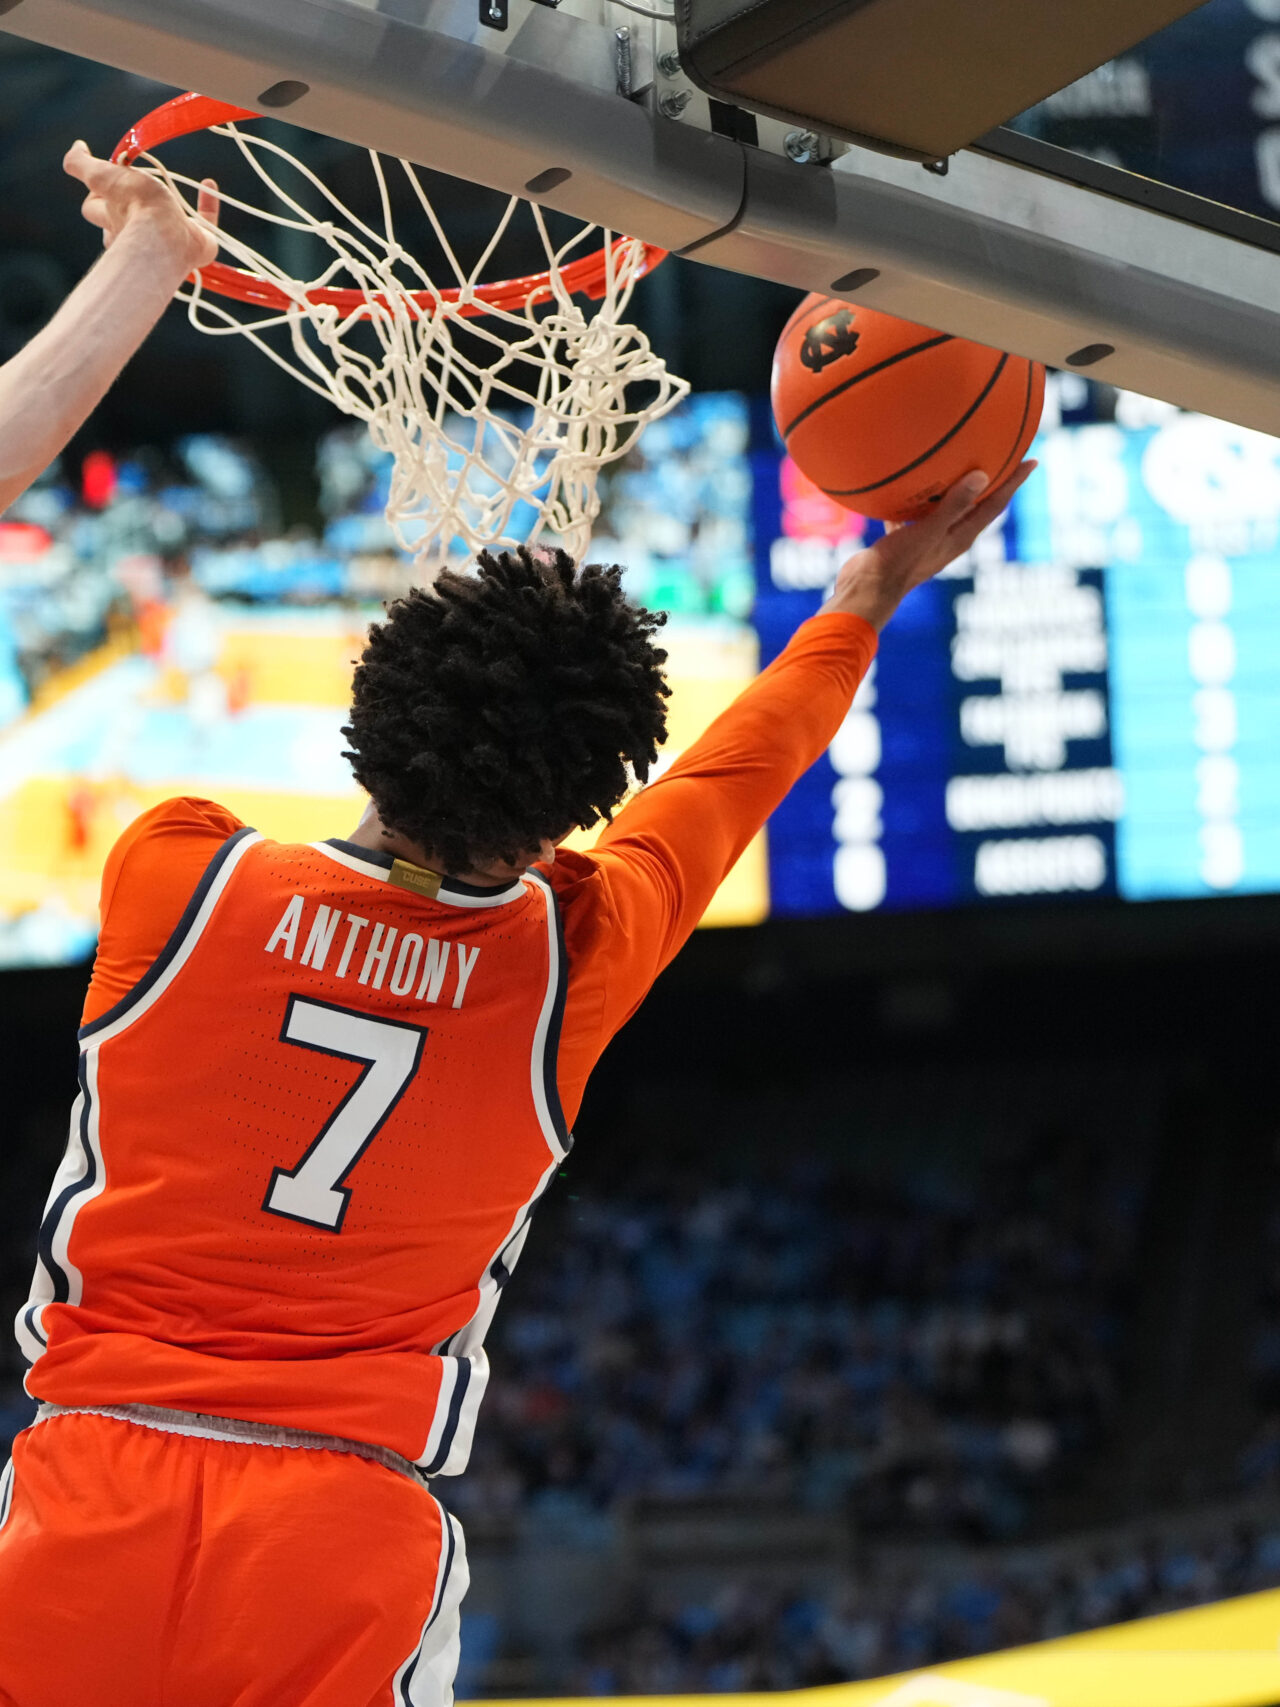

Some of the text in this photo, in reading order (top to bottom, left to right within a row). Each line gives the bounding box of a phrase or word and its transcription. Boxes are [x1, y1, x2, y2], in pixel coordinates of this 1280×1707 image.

[402, 870, 432, 888] CUSE
[264, 894, 480, 1009] ANTHONY
[261, 992, 429, 1234] 7
